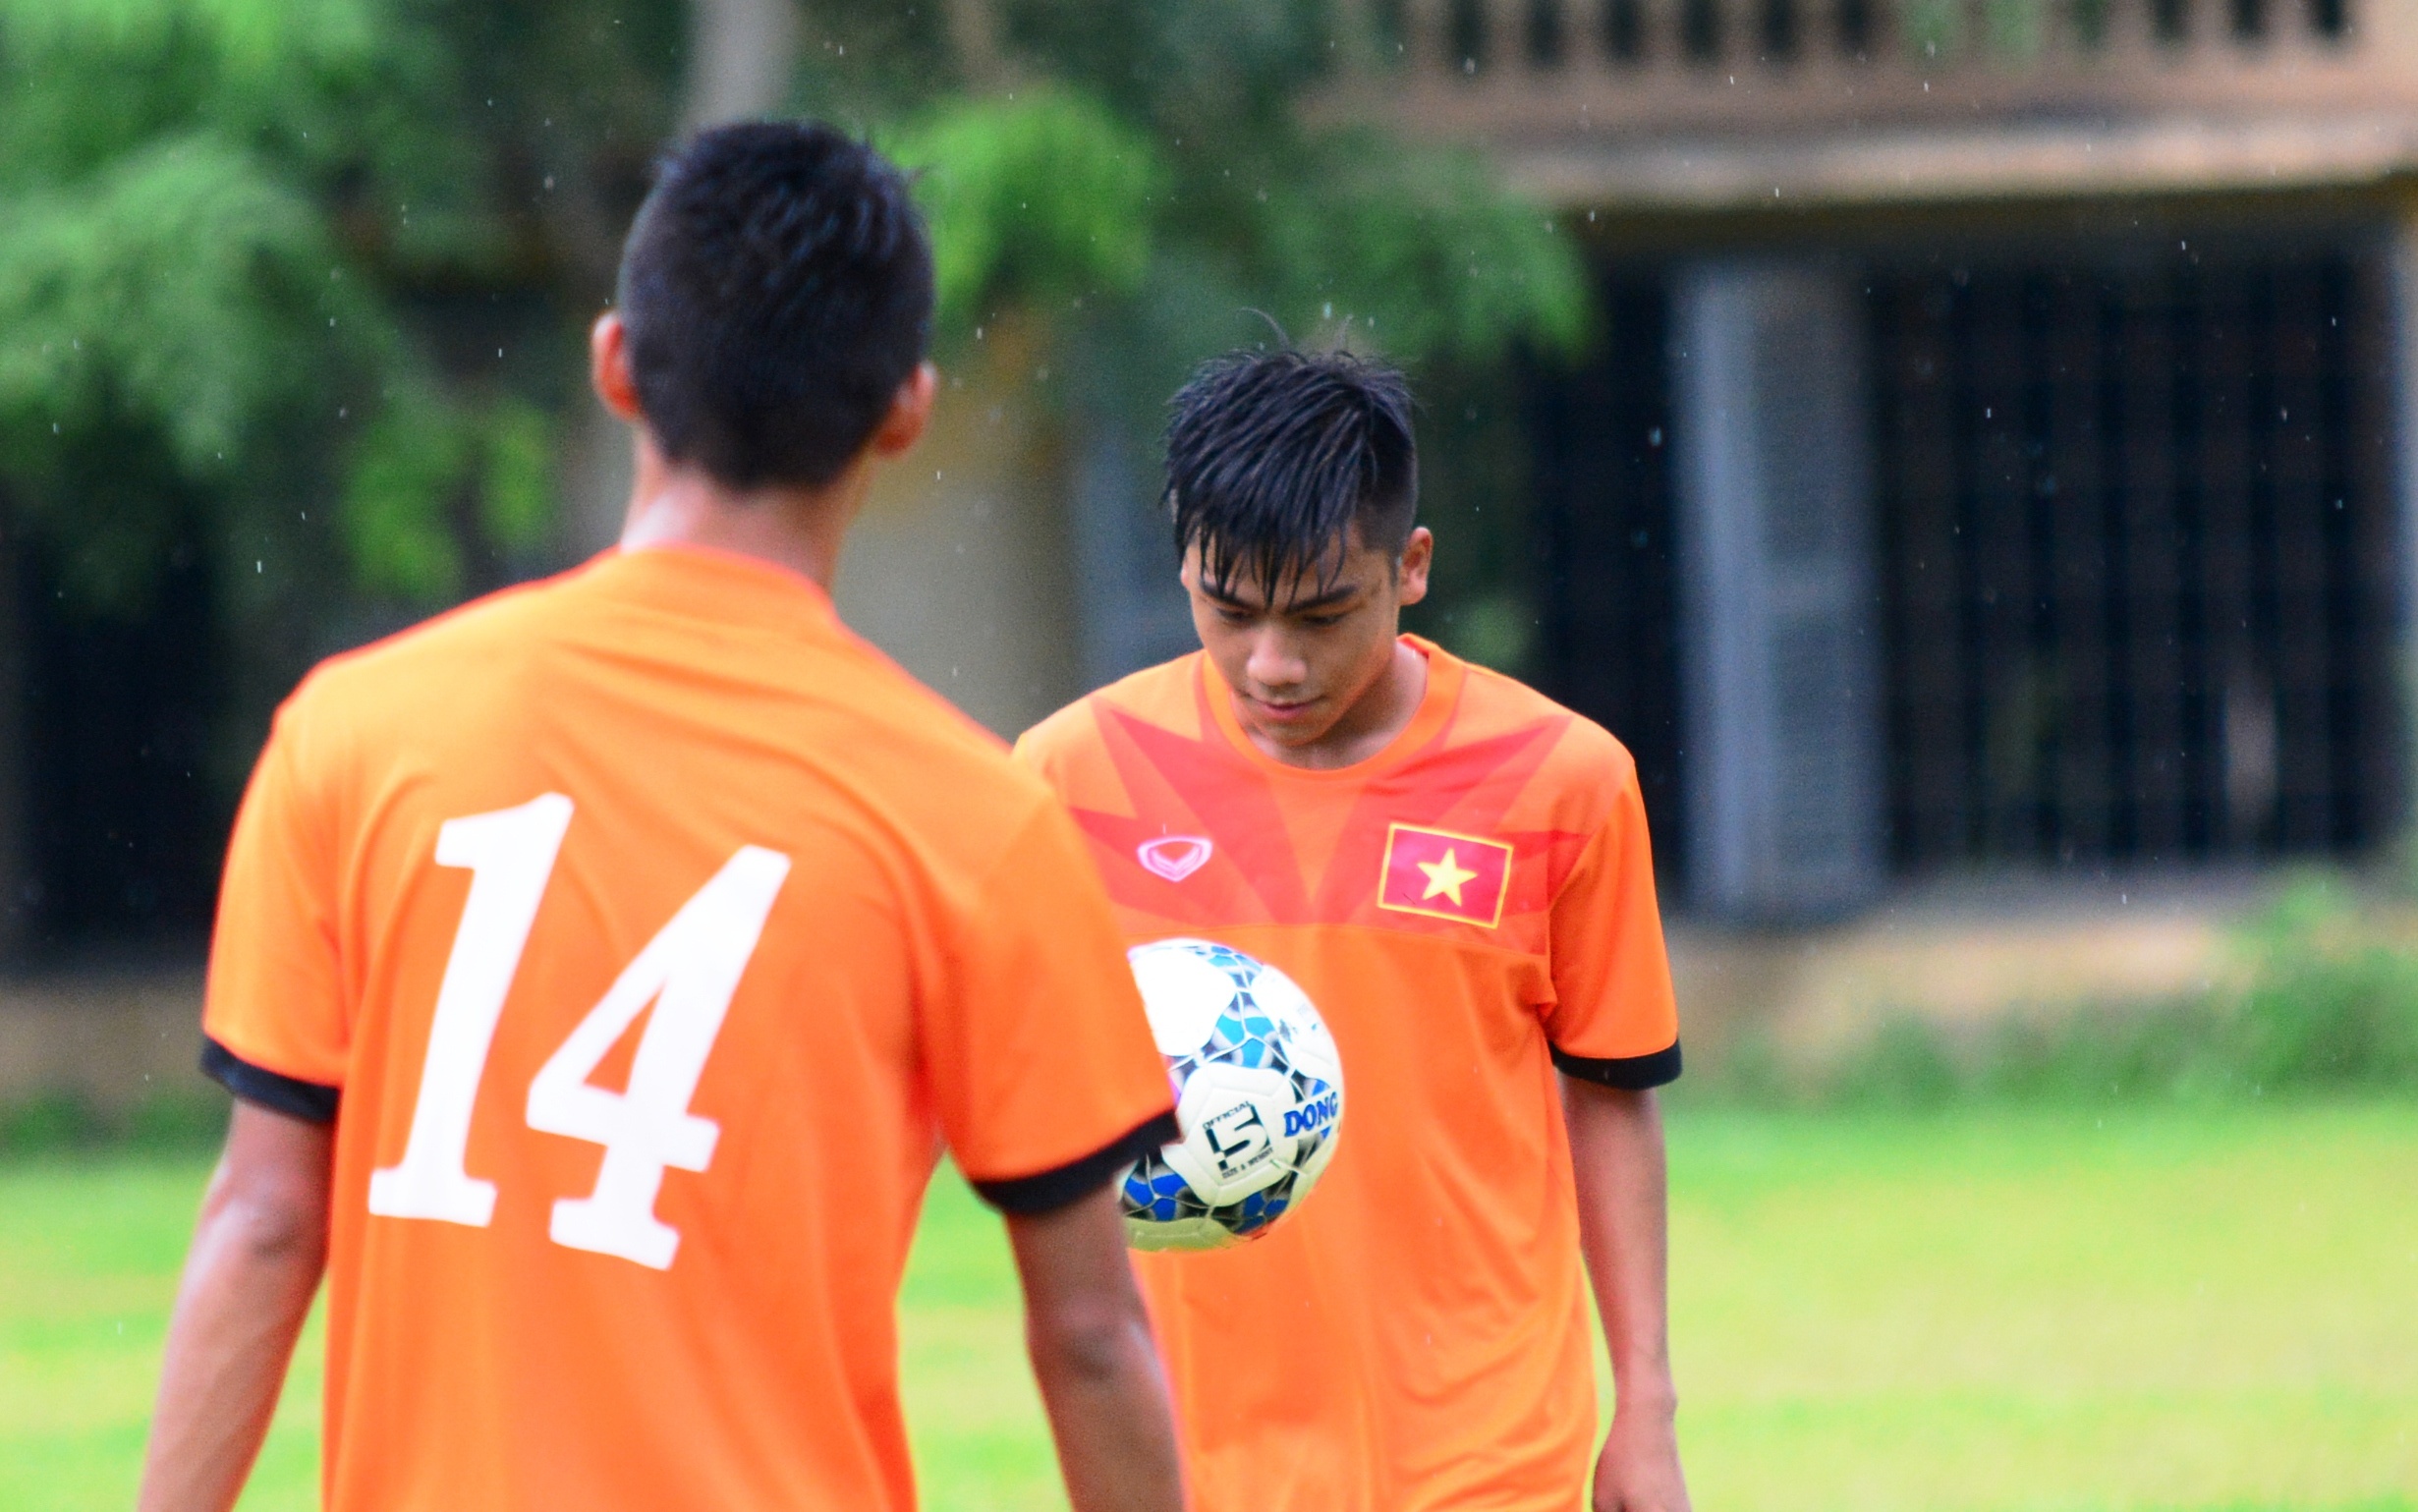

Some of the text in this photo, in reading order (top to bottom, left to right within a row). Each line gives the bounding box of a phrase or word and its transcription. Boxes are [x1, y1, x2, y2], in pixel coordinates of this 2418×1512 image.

[367, 792, 792, 1271] 14
[1202, 1100, 1251, 1130] OFFICIAL
[1206, 1104, 1270, 1171] 5
[1283, 1091, 1338, 1137] DONG
